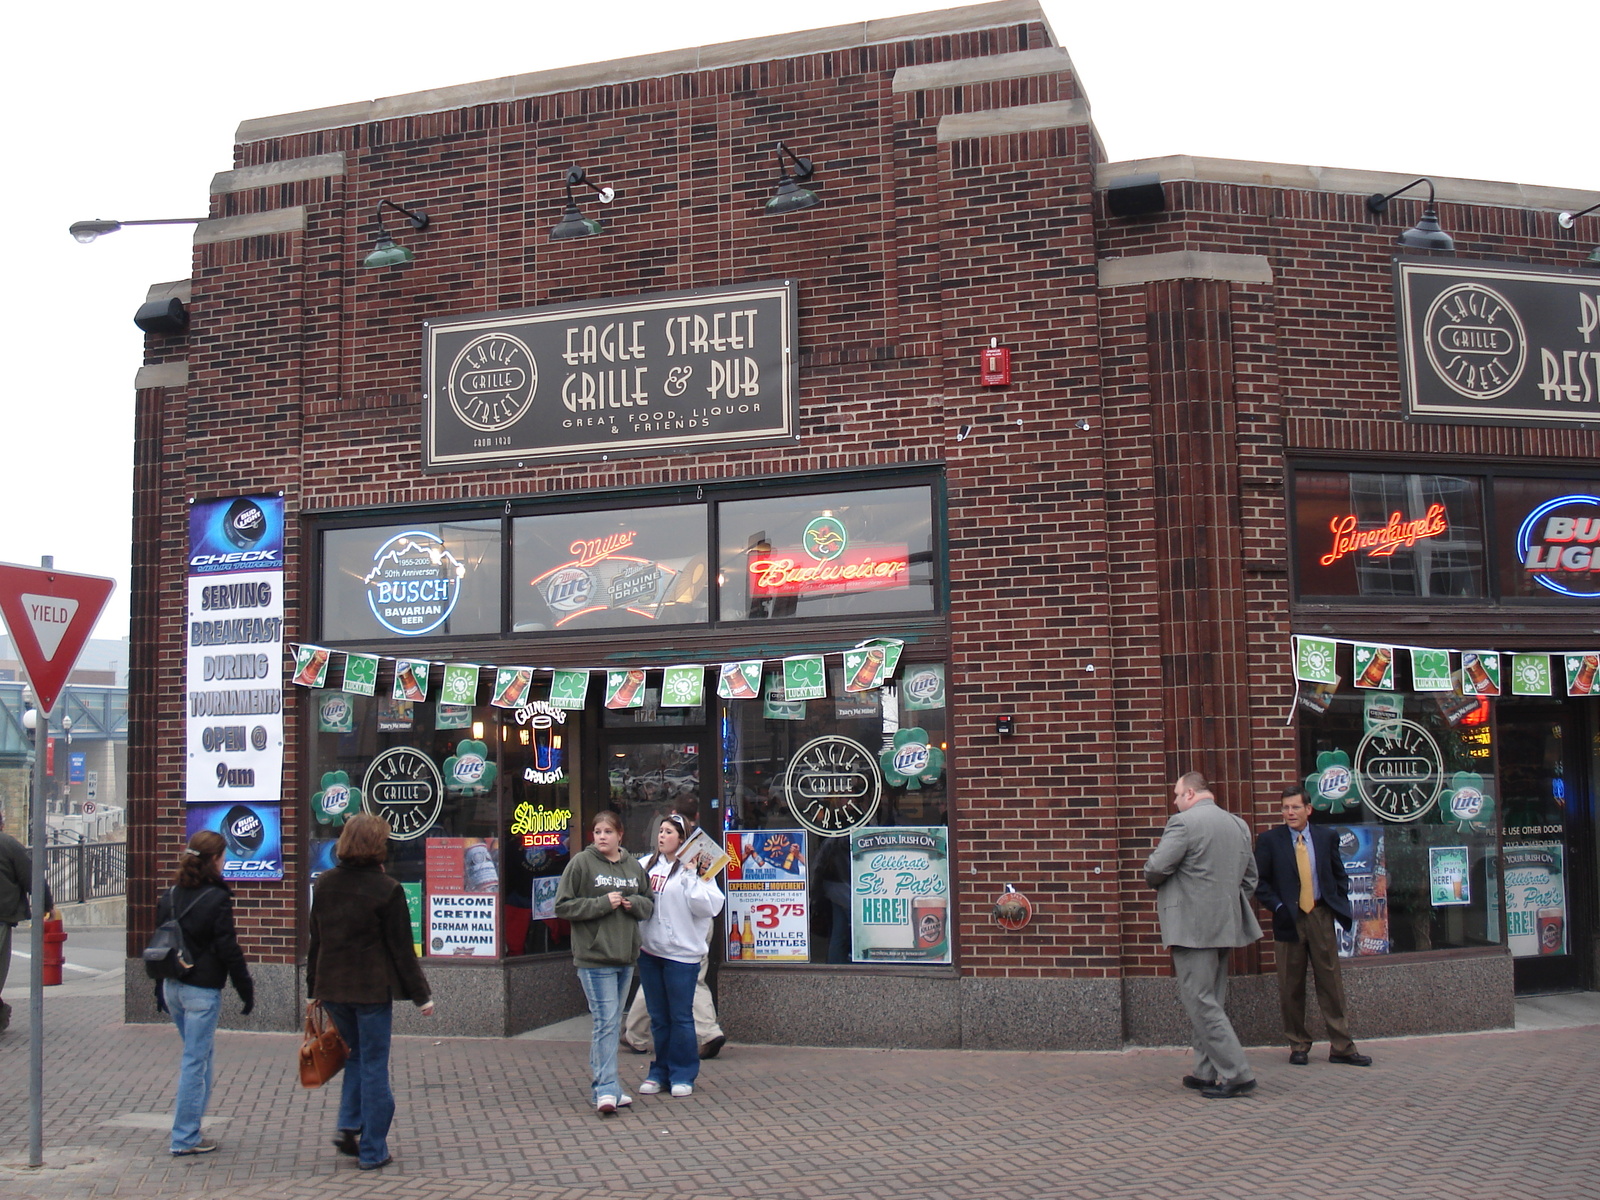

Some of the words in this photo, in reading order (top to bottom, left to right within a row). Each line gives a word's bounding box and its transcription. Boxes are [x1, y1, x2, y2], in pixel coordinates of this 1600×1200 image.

[1442, 293, 1502, 324] EAGLE
[1577, 292, 1600, 343] P
[562, 321, 645, 366] EAGLE
[665, 309, 758, 357] STREET
[1452, 331, 1498, 348] GRILLE
[466, 340, 519, 370] EAGLE
[472, 371, 513, 390] GRILLE
[1446, 355, 1509, 389] STREET
[562, 366, 648, 413] GRILLE
[663, 365, 692, 396] &
[706, 357, 760, 400] PUB
[464, 392, 521, 424] STREET
[562, 416, 616, 428] GREAT
[693, 403, 762, 417] LIQUOR
[611, 425, 620, 434] &
[634, 418, 710, 434] FRIENDS
[474, 438, 492, 447] FROM
[240, 508, 256, 520] BUD
[240, 511, 261, 528] LIGHT
[1319, 503, 1446, 566] Leinenkugel's
[570, 531, 637, 562] Miller
[190, 550, 278, 566] CHECK
[399, 558, 430, 568] 1955-2005
[384, 568, 400, 578] 50th
[401, 568, 440, 578] Anniversary
[750, 557, 906, 587] Budweiser
[377, 579, 450, 603] BUSCH
[550, 578, 590, 604] Lite
[608, 571, 660, 594] GENUINE
[614, 582, 654, 600] DRAFT
[201, 581, 272, 611] SERVING
[31, 603, 68, 624] YIELD
[384, 605, 442, 618] BAVARIAN
[401, 615, 424, 625] BEER
[190, 617, 283, 647] BREAKFAST
[1302, 643, 1316, 668] LUCKY
[1318, 644, 1332, 664] YOU
[203, 654, 268, 682] DURING
[1309, 667, 1330, 678] 2006
[1516, 658, 1531, 681] LUCKY
[1533, 658, 1546, 678] YOU
[346, 682, 362, 691] LUCKY
[446, 670, 460, 692] LUCKY
[464, 670, 475, 687] YOU
[667, 671, 684, 694] LUCKY
[687, 672, 700, 688] YOU
[912, 678, 938, 692] Lite
[1417, 678, 1436, 688] LUCKY
[1524, 680, 1546, 692] 2006
[452, 688, 472, 702] 2006
[674, 690, 697, 703] 2006
[788, 688, 807, 698] LUCKY
[190, 688, 280, 718] TOURNAMENTS
[326, 703, 345, 716] Lite
[552, 699, 568, 707] LUCKY
[202, 726, 247, 752] OPEN
[251, 725, 268, 750] @
[1372, 730, 1424, 756] EAGLE
[378, 754, 426, 780] EAGLE
[803, 744, 859, 772] EAGLE
[894, 752, 928, 772] Lite
[216, 762, 255, 788] 9am
[456, 762, 484, 776] Lite
[524, 767, 564, 784] DRAUGHT
[1379, 762, 1418, 776] GRILLE
[811, 778, 852, 793] GRILLE
[1319, 774, 1349, 793] Lite
[325, 790, 348, 808] Lite
[384, 786, 419, 800] GRILLE
[1372, 784, 1428, 814] STREET
[1452, 796, 1482, 812] Lite
[237, 816, 254, 826] BUD
[380, 806, 427, 832] STREET
[511, 802, 572, 835] Shiner
[803, 800, 863, 829] STREET
[237, 818, 260, 836] LIGHT
[1486, 827, 1506, 837] PLEE
[1508, 826, 1520, 835] USE
[1522, 826, 1542, 834] OTHER
[1544, 824, 1562, 834] DOOR
[524, 835, 560, 846] BOCK
[858, 838, 873, 848] GET
[874, 835, 897, 845] YOUR
[899, 835, 919, 845] IRISH
[920, 836, 935, 847] ON
[224, 860, 276, 870] ECK
[870, 854, 929, 870] Celebrate
[1506, 855, 1524, 864] YOUR
[1525, 854, 1541, 862] IRISH
[1541, 855, 1553, 863] ON
[770, 882, 804, 890] MOVEMENT
[856, 872, 887, 894] St.
[895, 872, 946, 894] Pat's
[1433, 876, 1452, 885] HERE!
[1504, 872, 1550, 886] Celebrate
[432, 898, 494, 906] WELCOME
[1524, 887, 1563, 908] Pat's
[434, 910, 492, 918] CRETIN
[862, 898, 908, 924] HERE!
[432, 922, 468, 931] DERHAM
[472, 923, 494, 931] HALL
[1508, 911, 1535, 935] ERE!
[445, 935, 493, 944] ALUMNI
[1360, 941, 1384, 950] LIGHT
